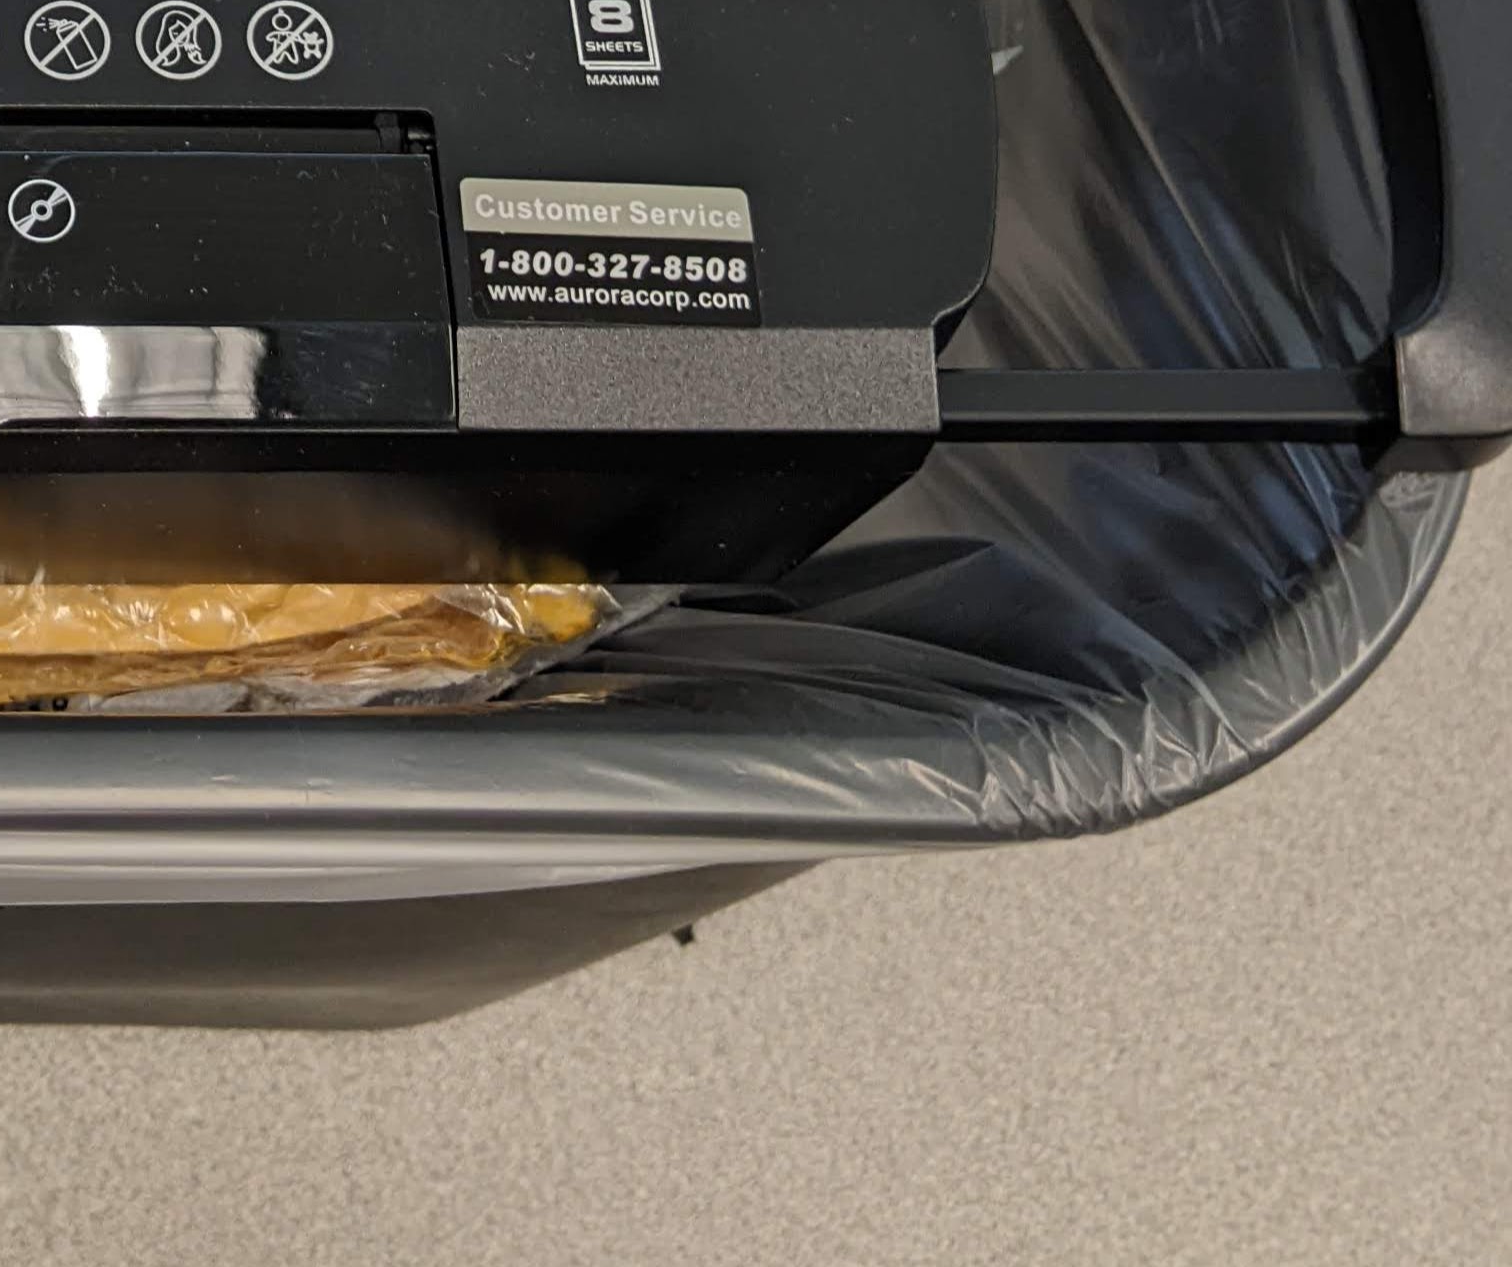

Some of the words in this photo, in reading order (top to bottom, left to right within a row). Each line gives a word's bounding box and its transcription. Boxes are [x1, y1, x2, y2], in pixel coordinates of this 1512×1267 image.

[589, 0, 633, 32] 8
[586, 41, 643, 52] SHEETS
[586, 74, 659, 85] MAXIMUM
[475, 193, 621, 224] Customer
[629, 201, 742, 229] Service
[480, 249, 746, 282] 1-800-327-8508
[488, 285, 750, 311] www.auroracorp.com
